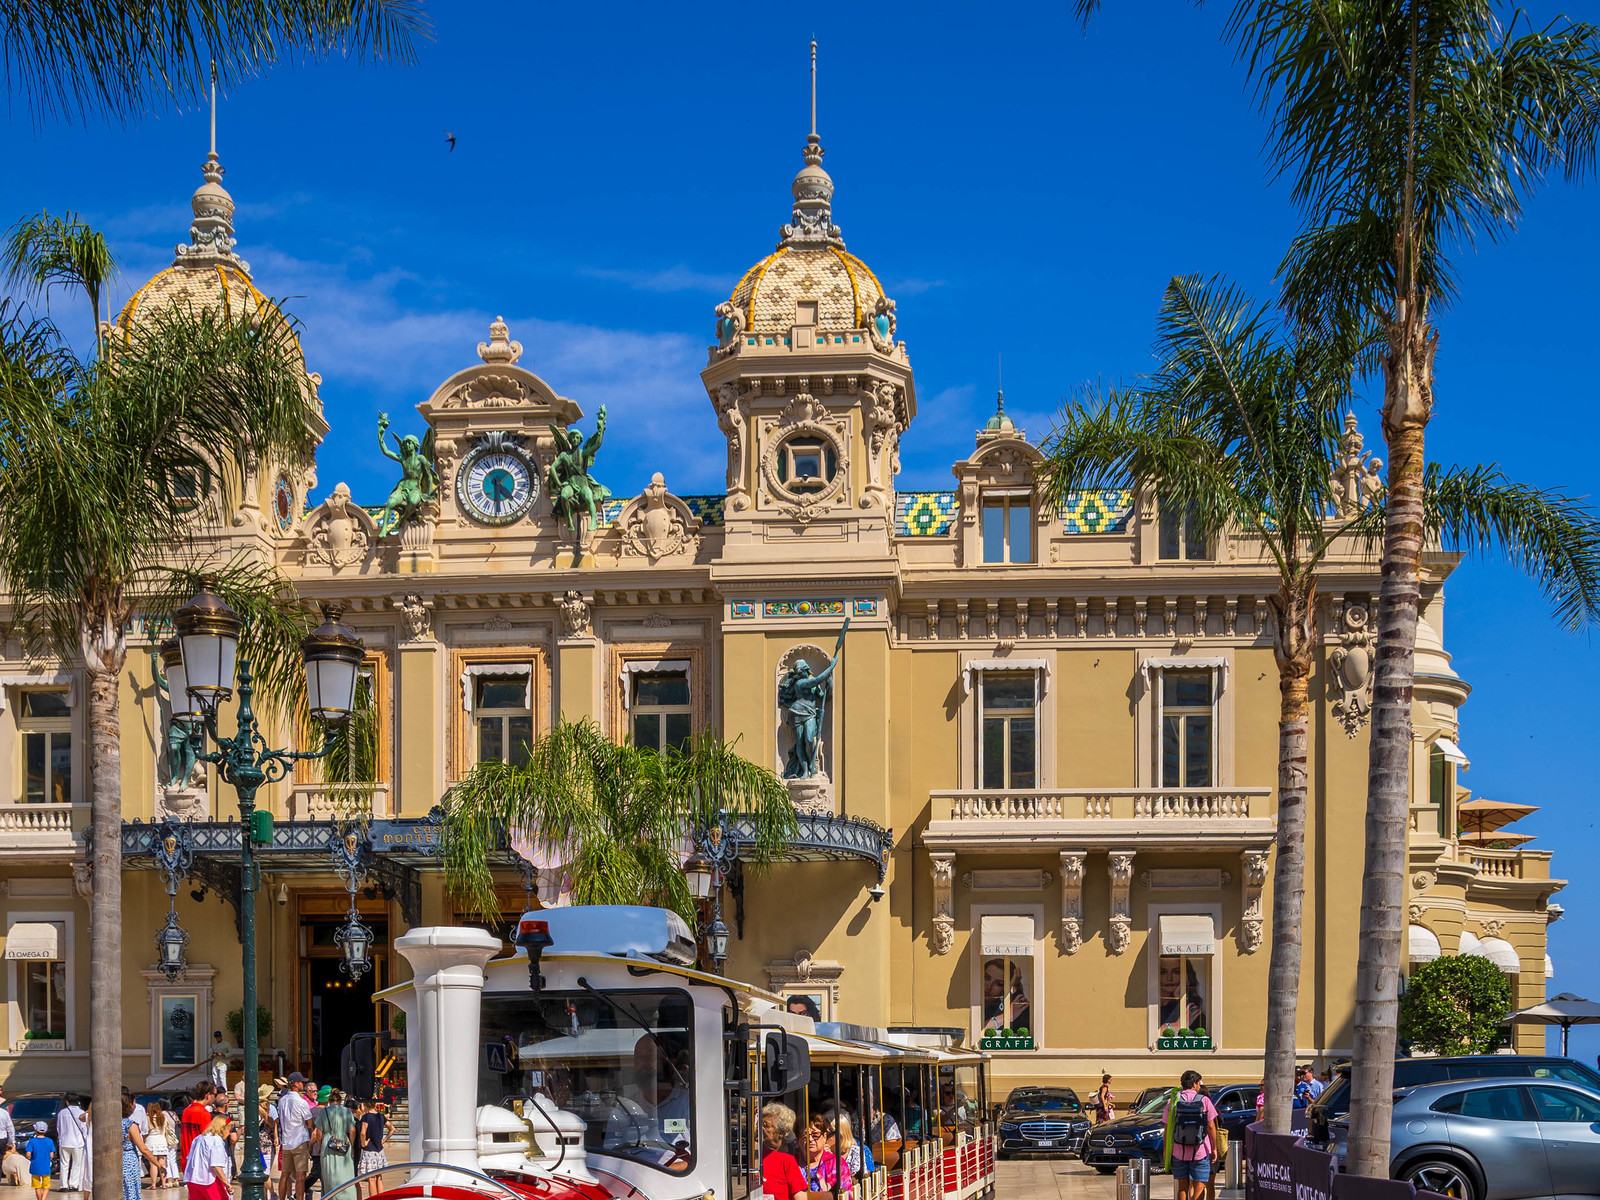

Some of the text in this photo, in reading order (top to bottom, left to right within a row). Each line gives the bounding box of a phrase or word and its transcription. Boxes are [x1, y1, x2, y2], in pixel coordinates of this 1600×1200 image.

[985, 946, 1030, 954] GRAFF
[1165, 945, 1210, 953] GRAFF
[985, 1040, 1029, 1048] GRAFF
[1163, 1040, 1207, 1048] GRAFF
